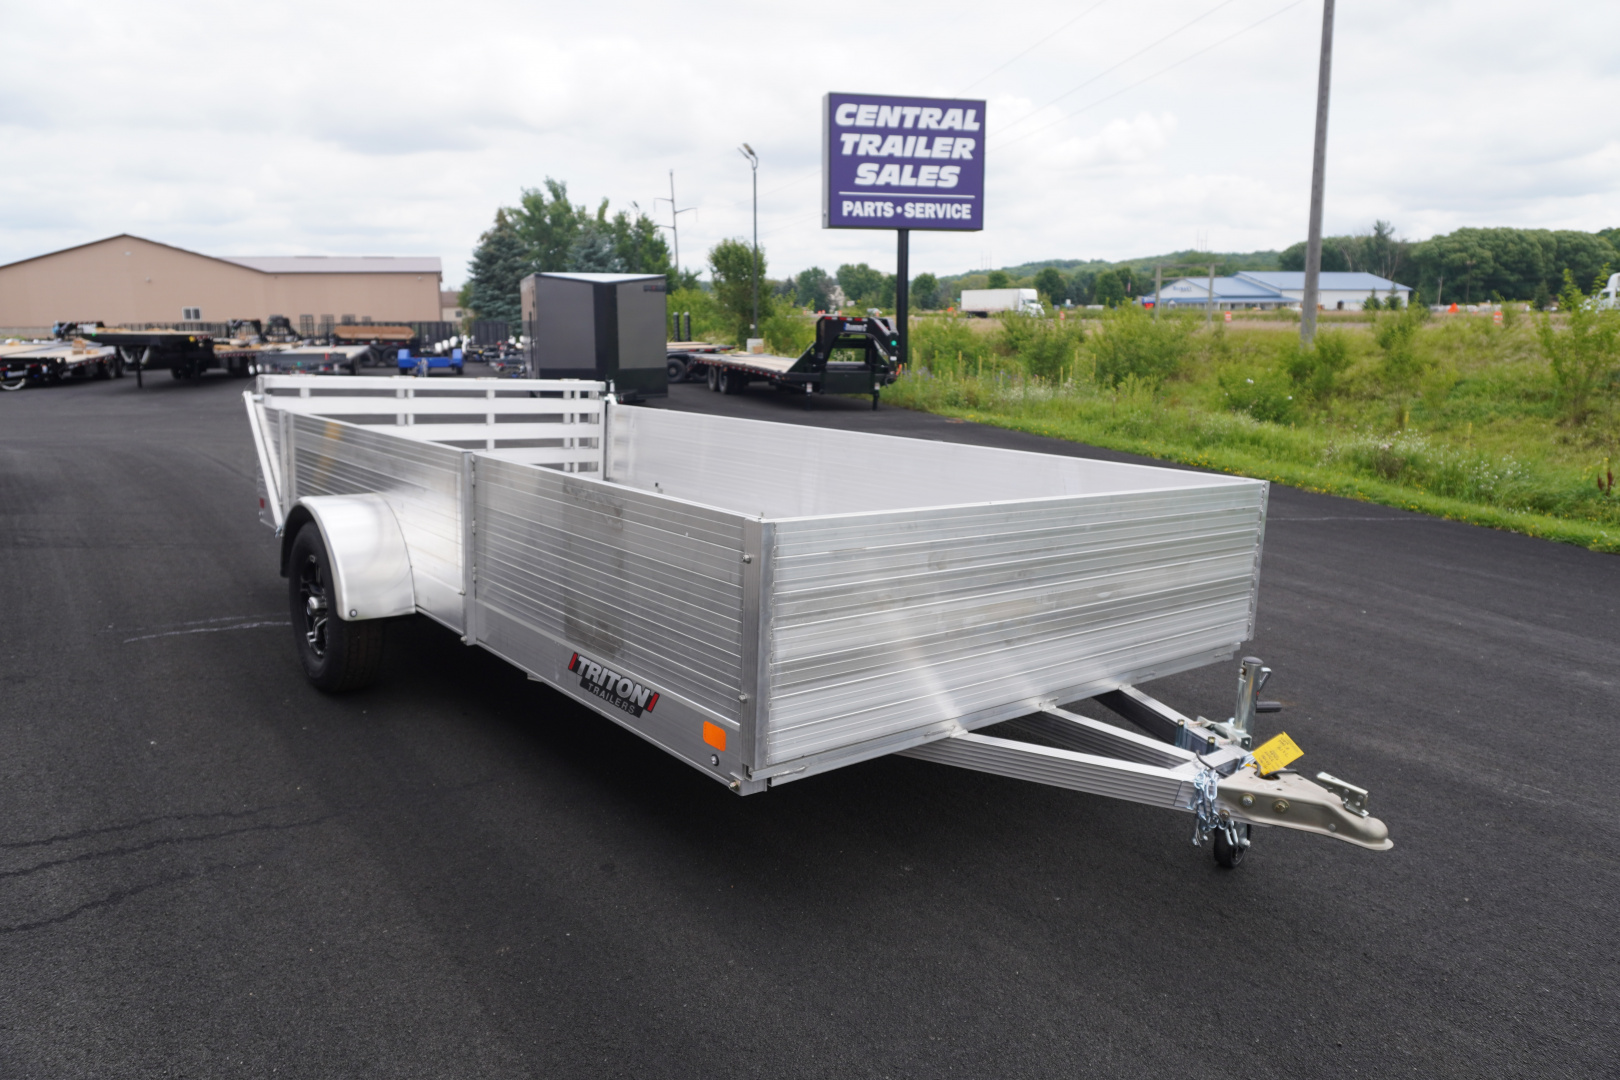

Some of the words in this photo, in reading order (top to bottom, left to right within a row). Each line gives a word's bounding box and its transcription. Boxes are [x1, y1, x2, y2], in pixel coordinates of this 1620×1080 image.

[835, 103, 980, 131] CENTRAL
[840, 133, 976, 160] TRAILER
[854, 162, 961, 188] SALES
[842, 200, 894, 217] PARTS
[904, 202, 972, 219] SERVICE
[577, 655, 651, 708] TRITON
[588, 682, 636, 715] TRAILERS
